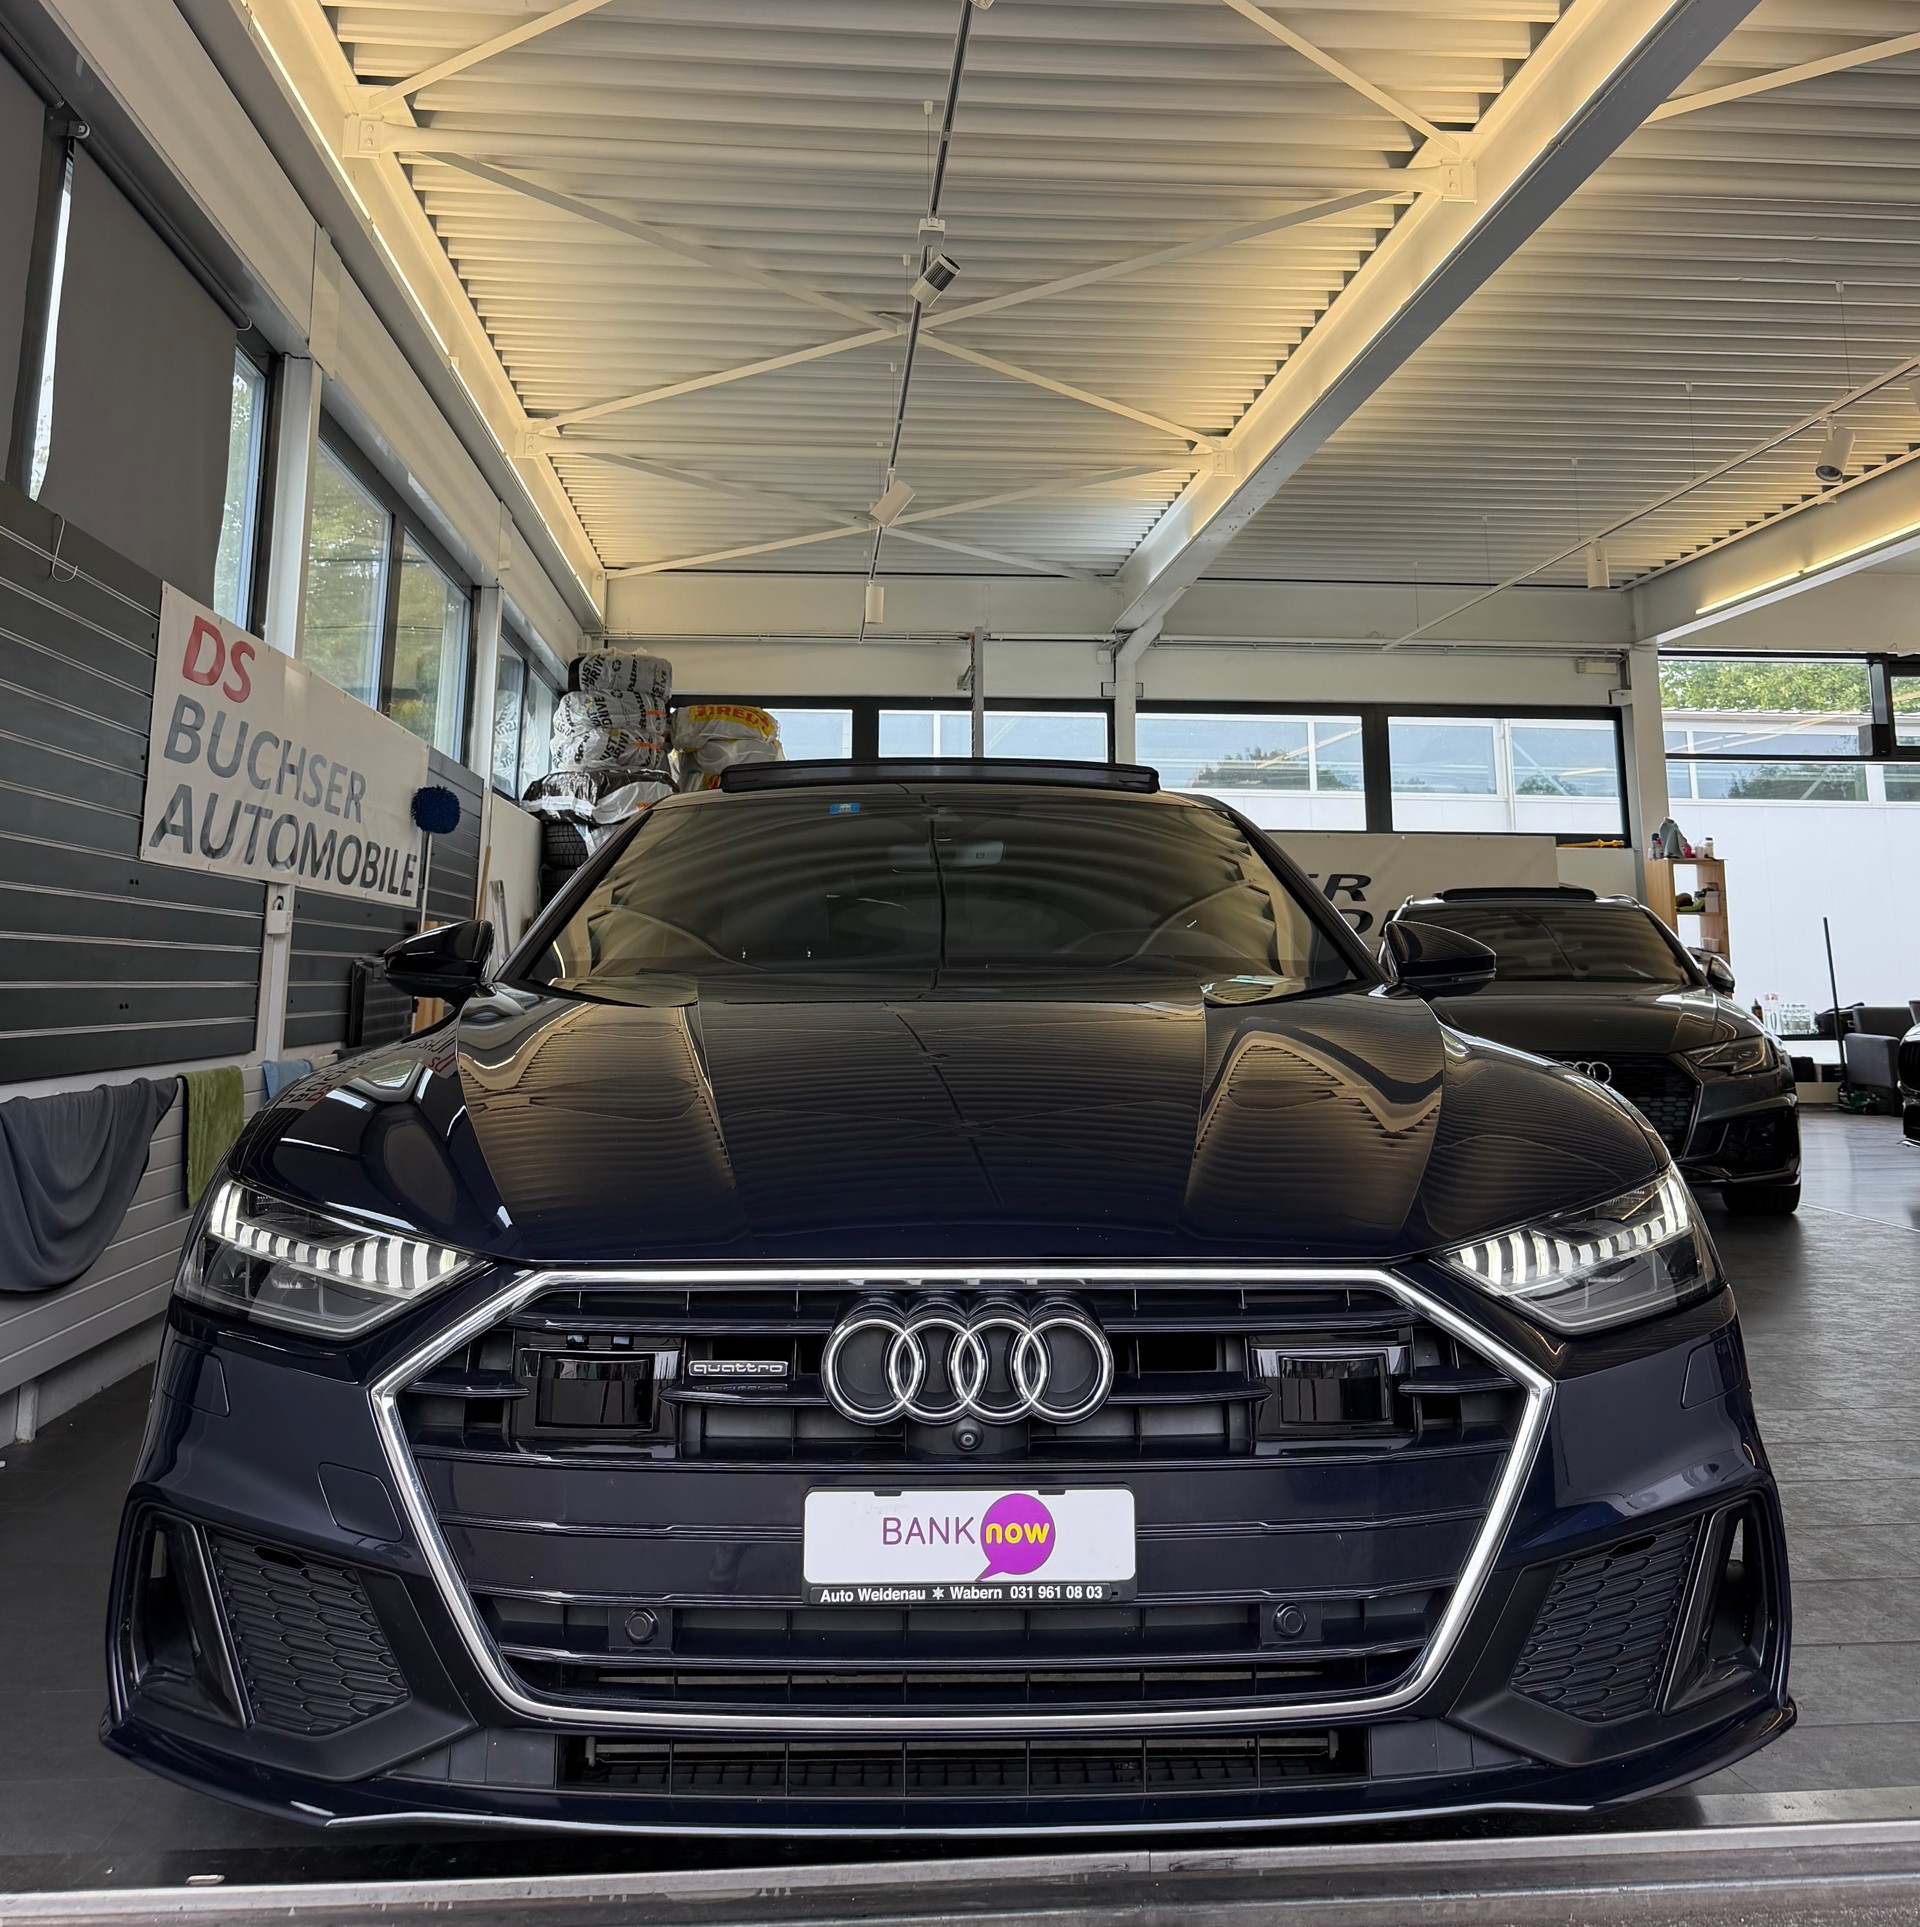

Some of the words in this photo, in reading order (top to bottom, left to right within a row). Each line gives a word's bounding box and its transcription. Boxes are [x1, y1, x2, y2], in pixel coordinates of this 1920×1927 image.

[182, 615, 255, 703] DS
[163, 694, 366, 824] BUCHSER
[149, 783, 417, 898] AUTOMOBILE
[693, 1363, 783, 1374] quattro
[882, 1516, 976, 1546] BANK
[985, 1522, 1050, 1545] now
[820, 1589, 853, 1603] Auto
[857, 1587, 926, 1602] Weidenau
[950, 1586, 1003, 1600] Wabern
[1010, 1586, 1033, 1600] 031
[1038, 1586, 1061, 1599] 961
[1066, 1586, 1083, 1599] 08
[1086, 1586, 1103, 1599] 03
